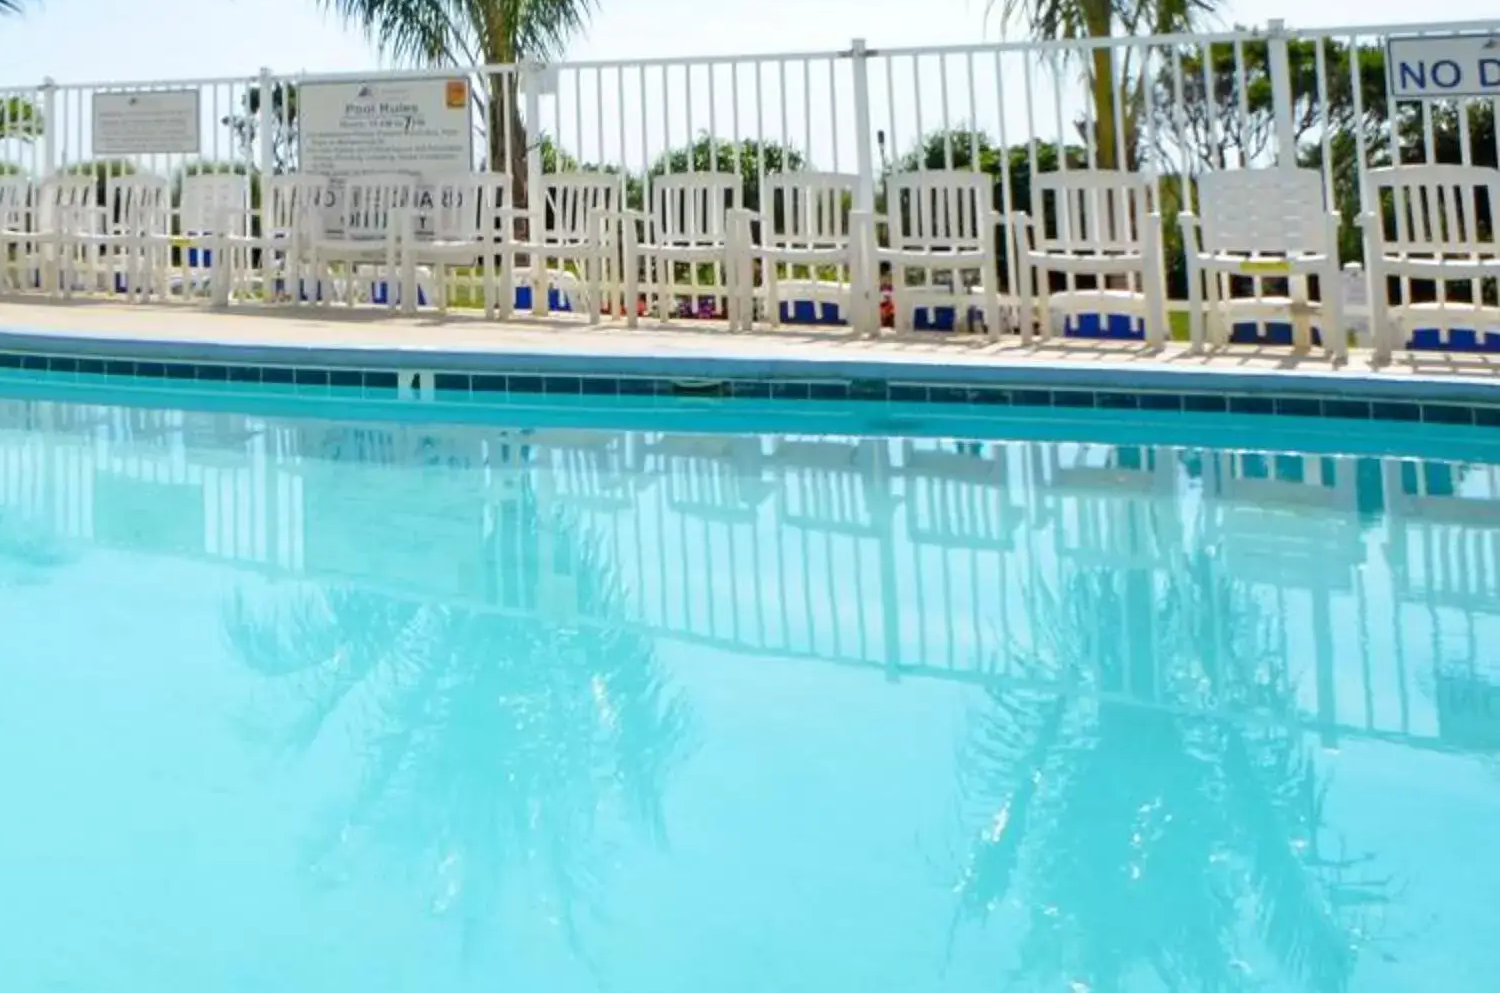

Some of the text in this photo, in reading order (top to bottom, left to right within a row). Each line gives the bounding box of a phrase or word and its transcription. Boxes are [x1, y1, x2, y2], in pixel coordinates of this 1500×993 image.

[1399, 59, 1461, 90] NO
[345, 102, 418, 114] Pool Rules
